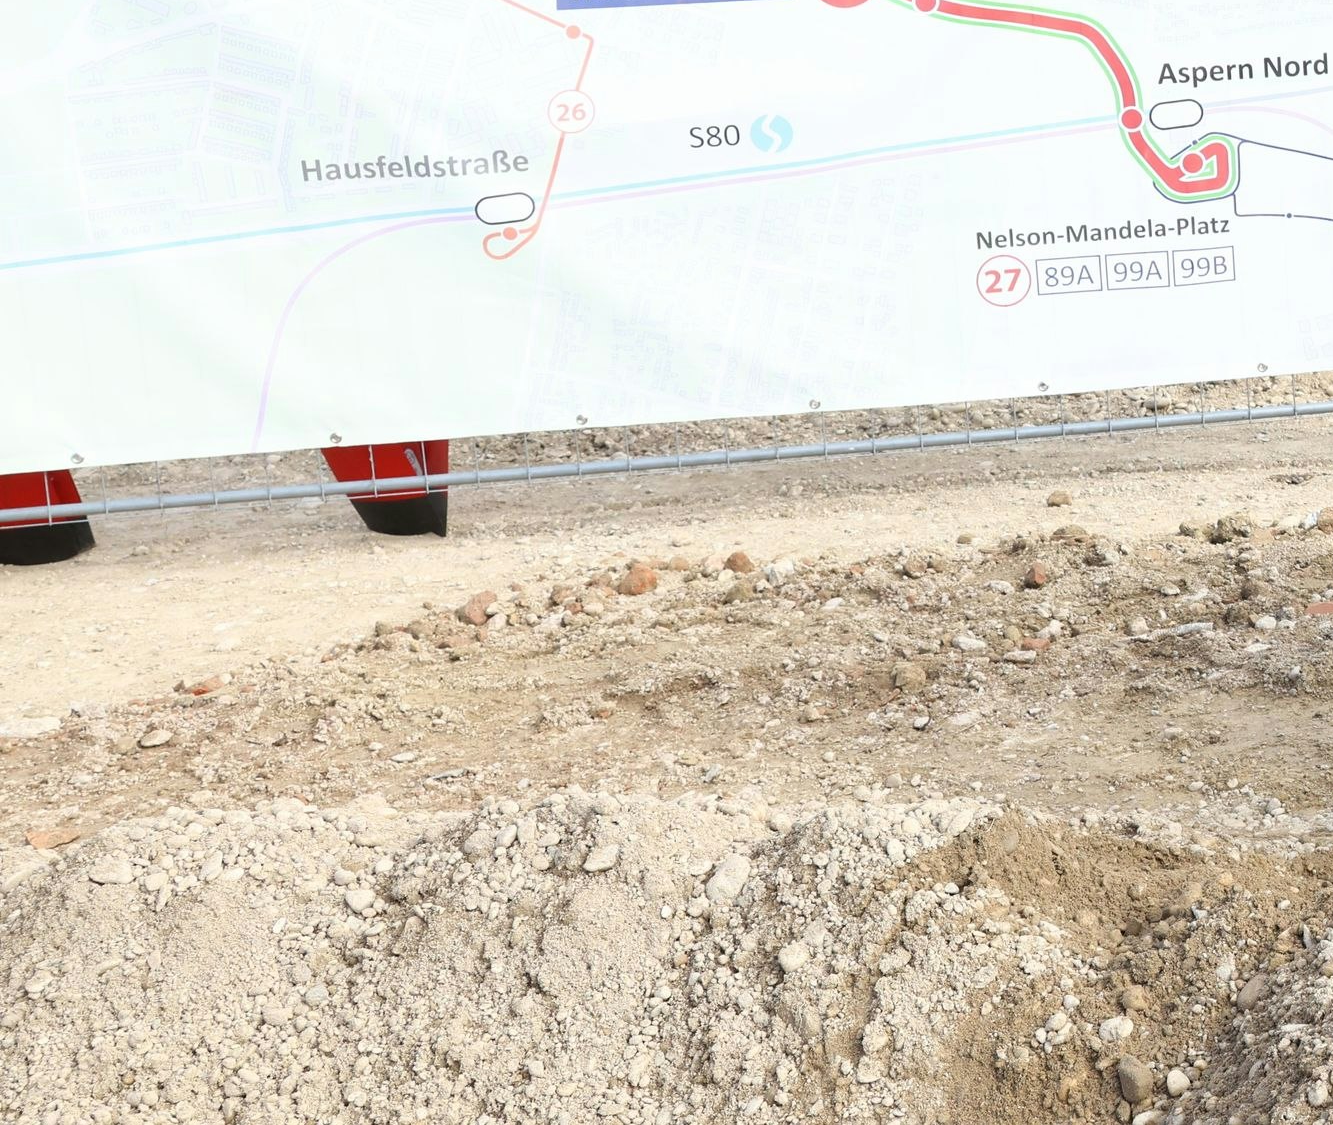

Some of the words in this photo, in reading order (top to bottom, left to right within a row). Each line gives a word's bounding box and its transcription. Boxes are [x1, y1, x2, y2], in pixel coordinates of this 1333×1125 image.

[1157, 62, 1254, 90] Aspern
[1263, 52, 1329, 79] Nord
[556, 103, 587, 122] 26
[689, 125, 741, 149] S80
[300, 149, 530, 183] Hausfeldstraße
[976, 216, 1231, 250] Nelson-Mandela-Platz
[984, 268, 1022, 294] 27
[1044, 264, 1095, 288] 89A
[1112, 260, 1163, 283] 99A
[1180, 255, 1229, 279] 99B
